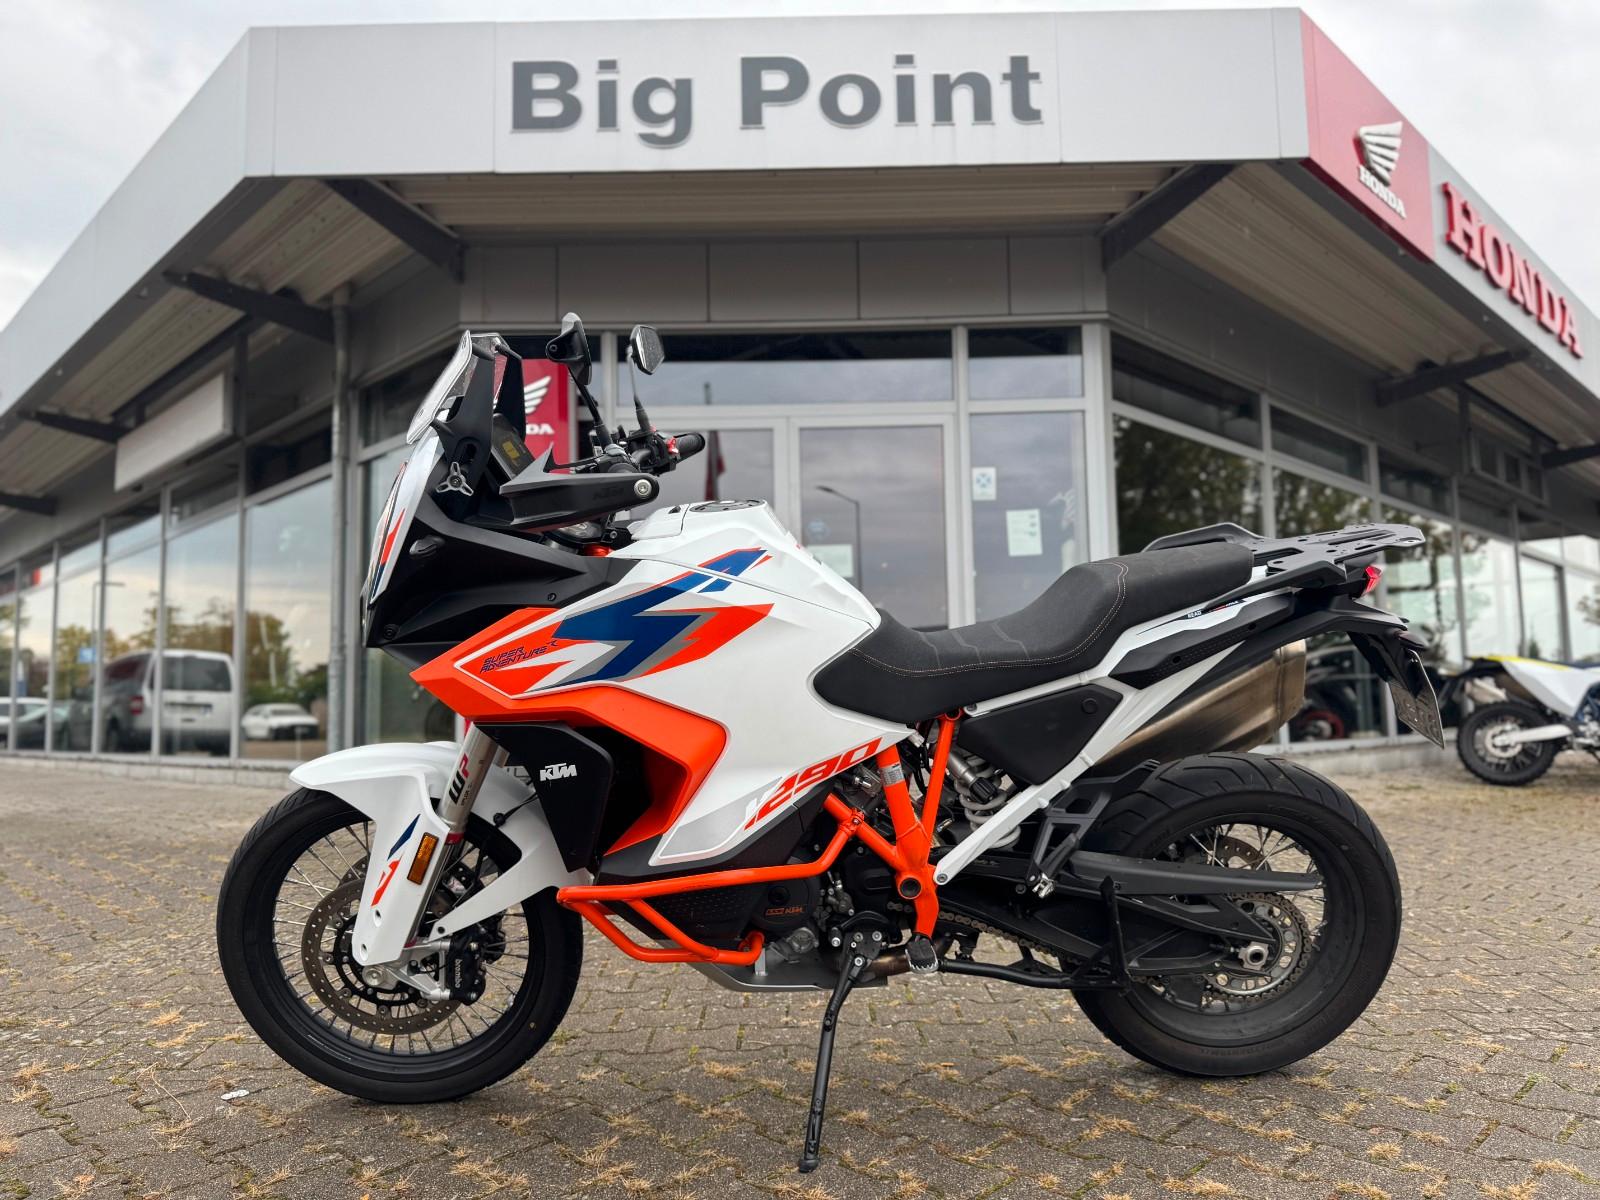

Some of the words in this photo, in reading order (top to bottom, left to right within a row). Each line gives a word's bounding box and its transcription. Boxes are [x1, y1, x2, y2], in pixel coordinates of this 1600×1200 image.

[512, 59, 693, 148] Big
[740, 54, 1043, 127] Point
[1357, 164, 1407, 219] HONDA
[1441, 181, 1583, 359] HONDA
[479, 646, 548, 674] ADVENTURE
[483, 646, 525, 665] SUPER
[448, 752, 470, 805] WP
[539, 762, 578, 782] KTM
[454, 958, 463, 989] brembo
